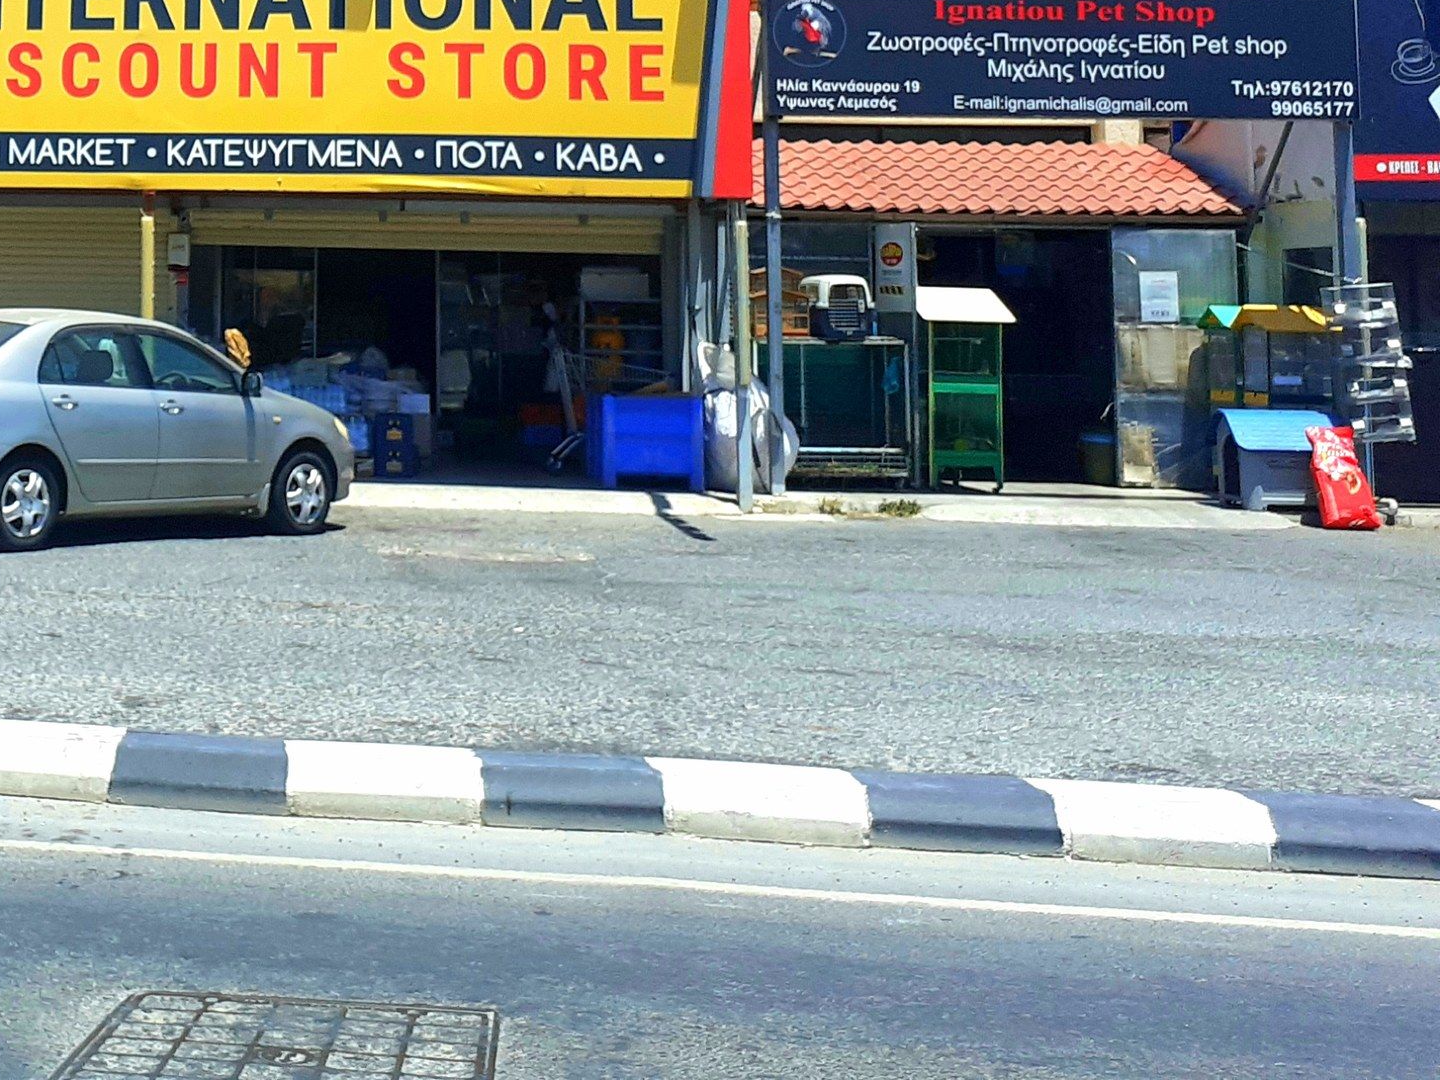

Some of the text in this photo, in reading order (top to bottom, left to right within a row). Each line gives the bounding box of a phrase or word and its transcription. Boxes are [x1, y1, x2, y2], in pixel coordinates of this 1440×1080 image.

[1076, 0, 1125, 22] Pet
[1135, 0, 1216, 27] Shop
[866, 31, 1288, 59] Ζωοτροφές-Πτηνοτροφές-Είδη Pet shop
[386, 41, 665, 102] STORE
[987, 58, 1166, 83] Μιχάλης Ιγνατίου
[776, 78, 809, 93] Ηλία
[903, 80, 920, 94] 19
[1230, 79, 1355, 100] Τηλ:97612170
[776, 94, 898, 112] Υψωνας Λεμεσός
[953, 93, 1189, 115] E-mail:ignamichalis@gmail.com
[1270, 100, 1355, 117] 99065177
[8, 138, 136, 167] MARKET
[166, 138, 643, 173] ΚΑΤΕΨΥΓΜΕΝΑ ΠΟΤΑ ΚΑΒΑ
